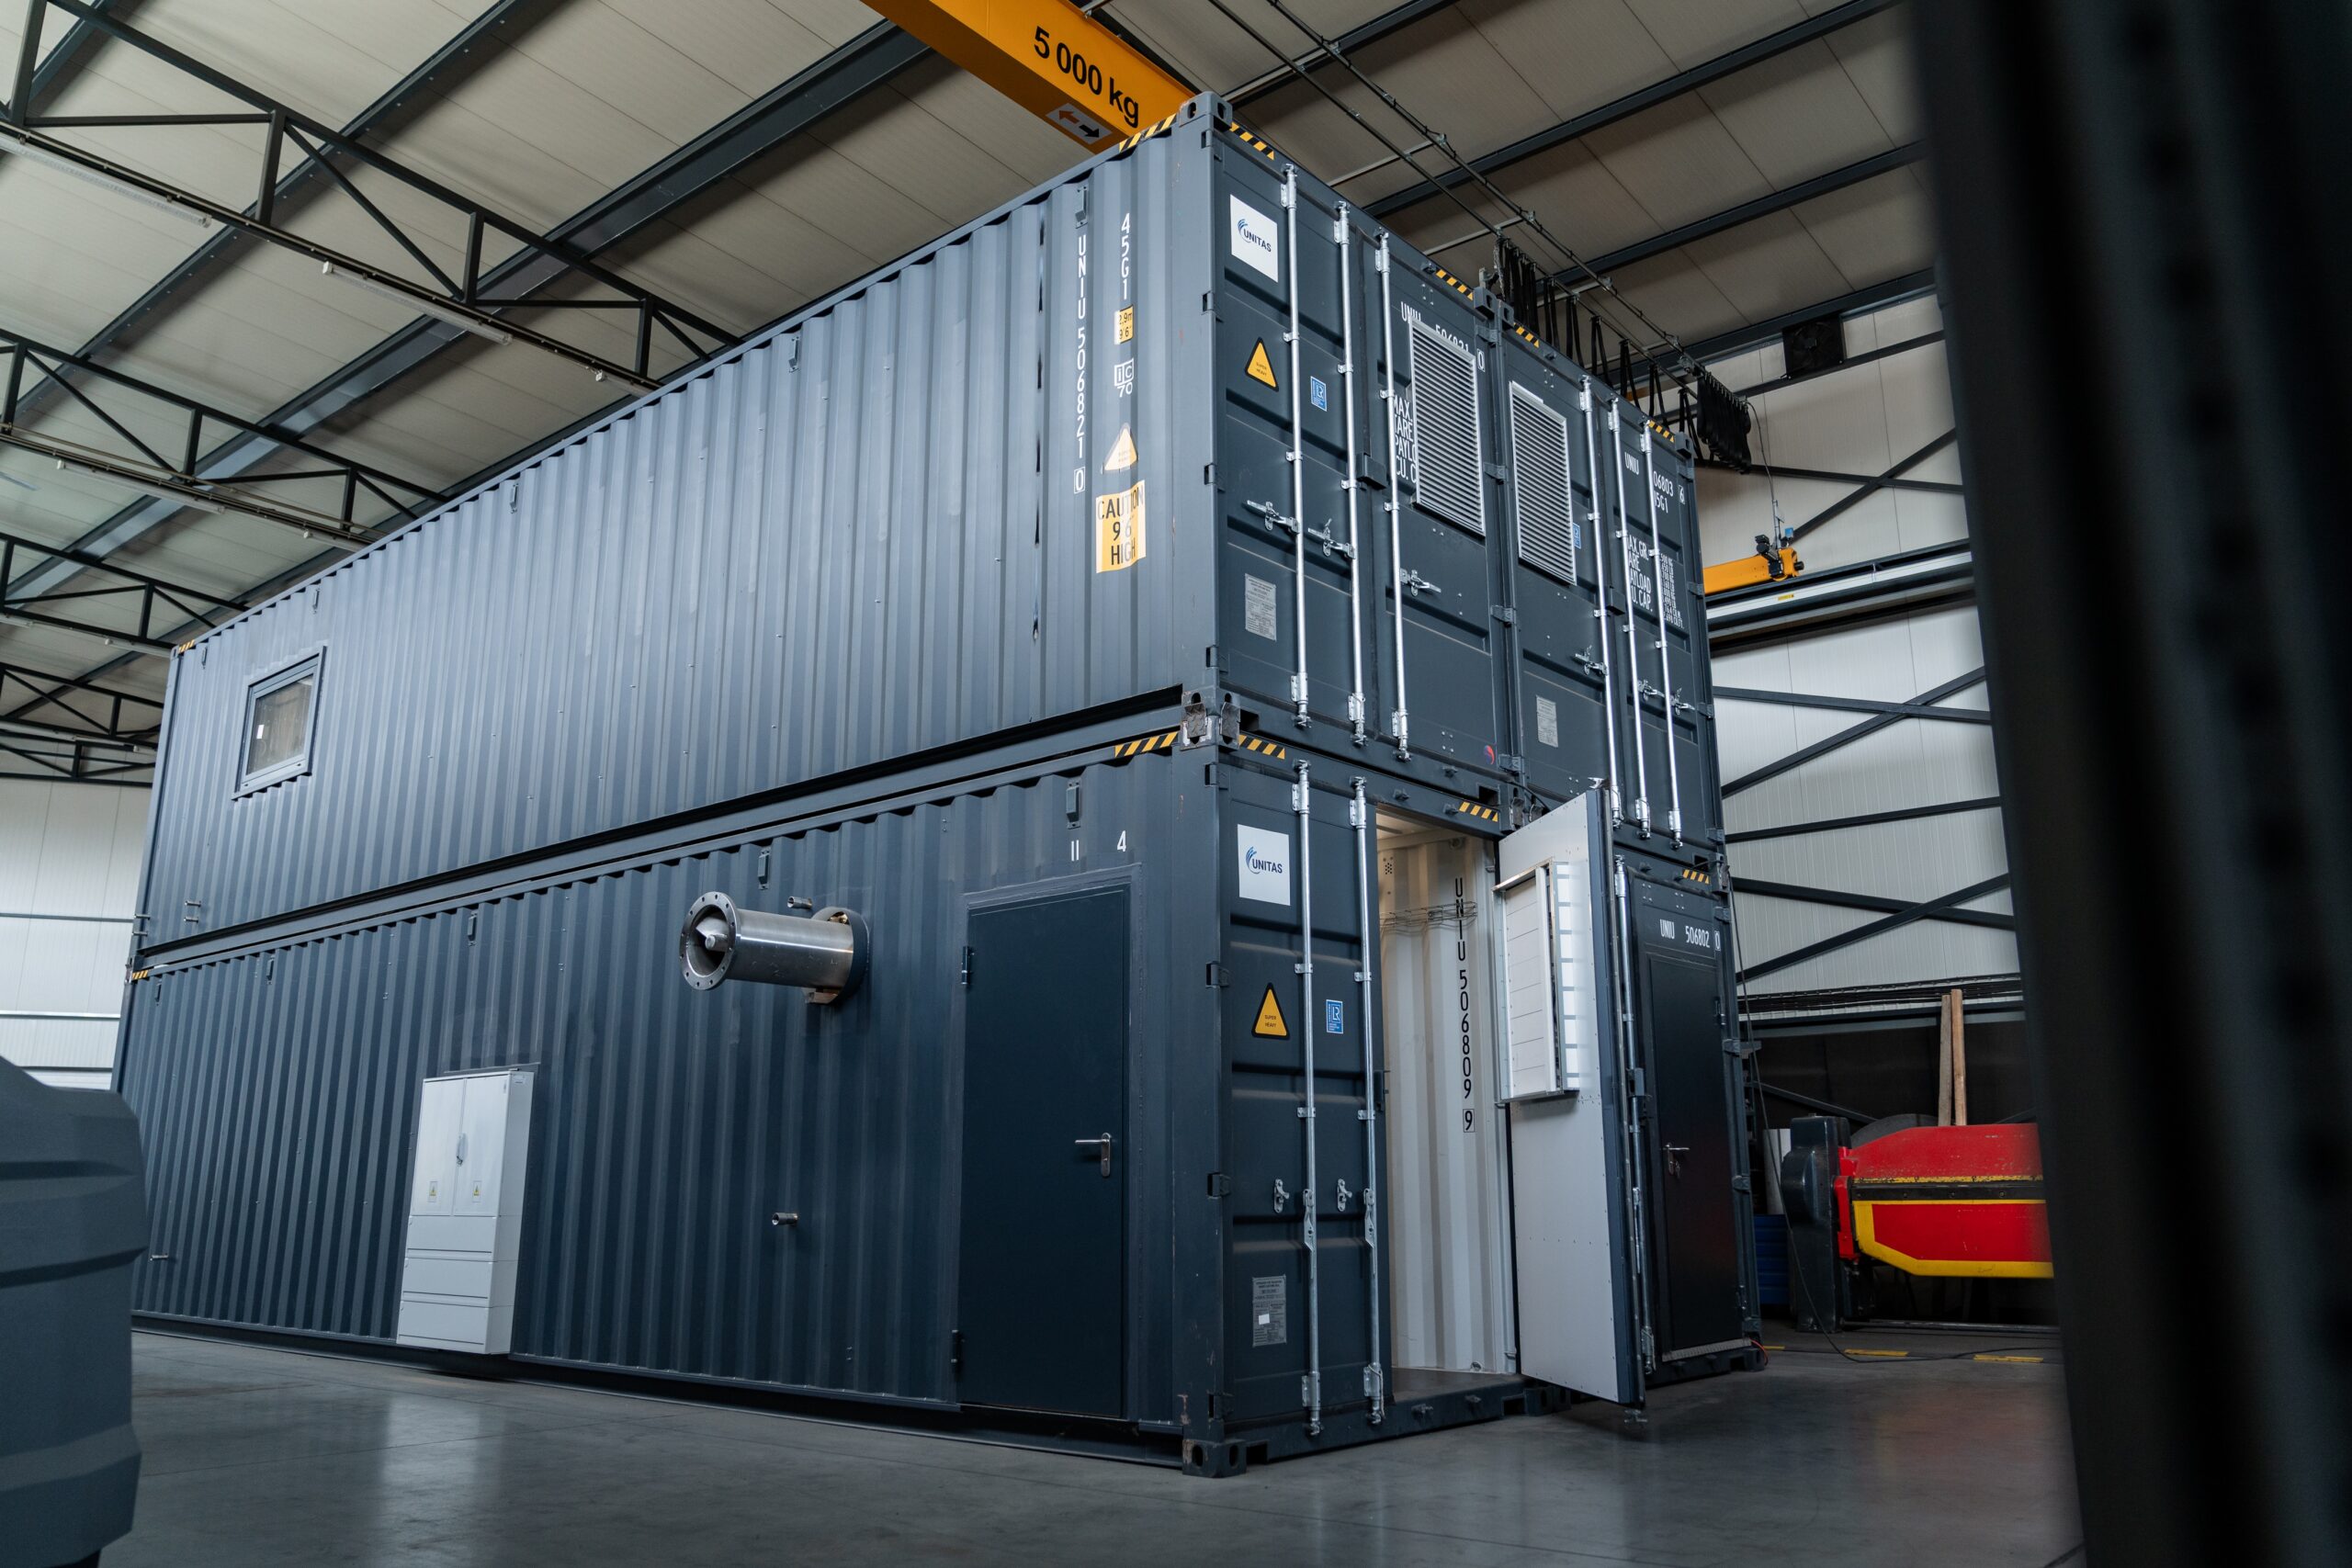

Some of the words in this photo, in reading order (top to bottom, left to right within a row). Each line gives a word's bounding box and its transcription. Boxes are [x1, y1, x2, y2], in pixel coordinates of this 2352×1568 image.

[1034, 26, 1051, 60] 5
[1057, 42, 1102, 96] 000
[1109, 77, 1139, 129] kg
[1243, 229, 1272, 253] UNITAS
[1121, 213, 1131, 300] 45G1
[1078, 234, 1087, 320] UNIU
[1076, 327, 1087, 458] 506821
[1116, 381, 1133, 398] 70
[1624, 452, 1639, 475] UNIU
[1098, 485, 1144, 520] CAUTION
[1111, 537, 1136, 566] HIGH
[1116, 829, 1127, 852] 4
[1252, 859, 1283, 874] UNITAS
[1659, 919, 1675, 940] UNIU
[1685, 925, 1710, 949] 506802
[1459, 969, 1472, 1100] 506809
